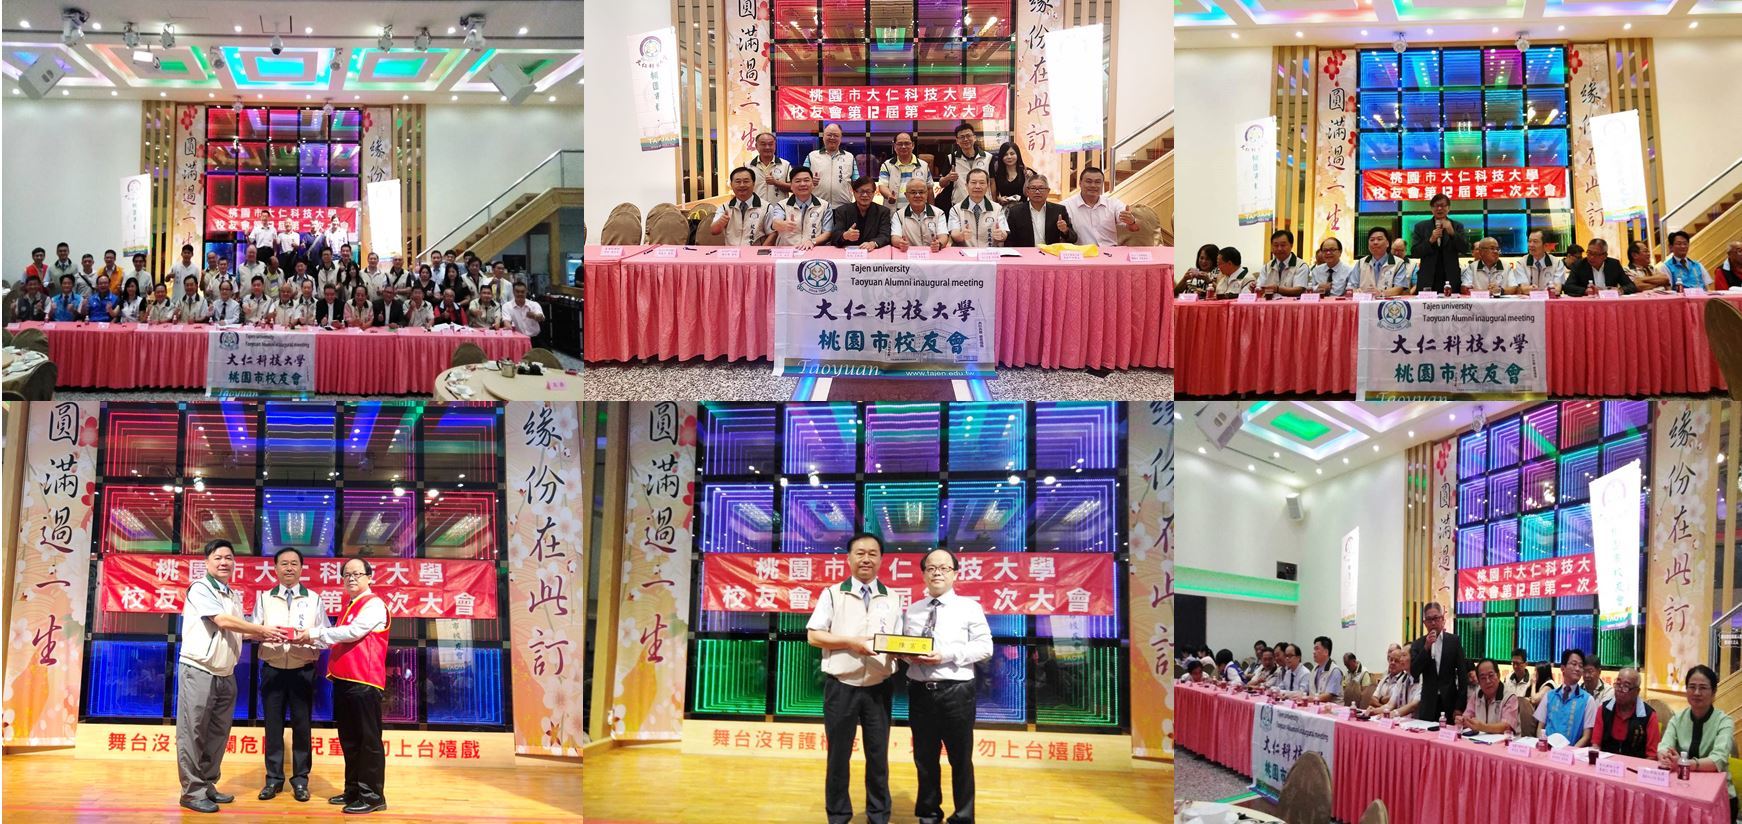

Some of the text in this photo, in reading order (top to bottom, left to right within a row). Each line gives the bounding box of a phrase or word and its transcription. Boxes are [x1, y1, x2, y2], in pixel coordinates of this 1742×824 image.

[809, 87, 977, 102] 桃園市大仁科技大學
[790, 104, 996, 119] 校友會第12屆第一次大會
[1389, 169, 1540, 184] 桃園市大仁科技大學
[851, 263, 910, 274] Tajen university
[851, 277, 984, 289] Taoyuan Alumni inaugural meeting
[813, 299, 975, 323] 大仁科技大學
[1422, 302, 1473, 311] Tajen university
[1423, 314, 1536, 324] Taoyuan Alumni inaugural meeting
[818, 329, 969, 354] 桃園市校友會
[1390, 333, 1529, 355] 大仁科技大學
[226, 353, 305, 367] 大仁科技大學
[798, 359, 880, 378] Taoyuan
[228, 370, 302, 386] 桃園市校友會
[1394, 362, 1525, 385] 桃園市校友會
[1664, 410, 1697, 632] 緣份在此訂
[522, 407, 568, 676] 緣份在此訂
[156, 559, 443, 586] 桃園市大科大學
[755, 556, 1056, 582] 桃園市仁技大學
